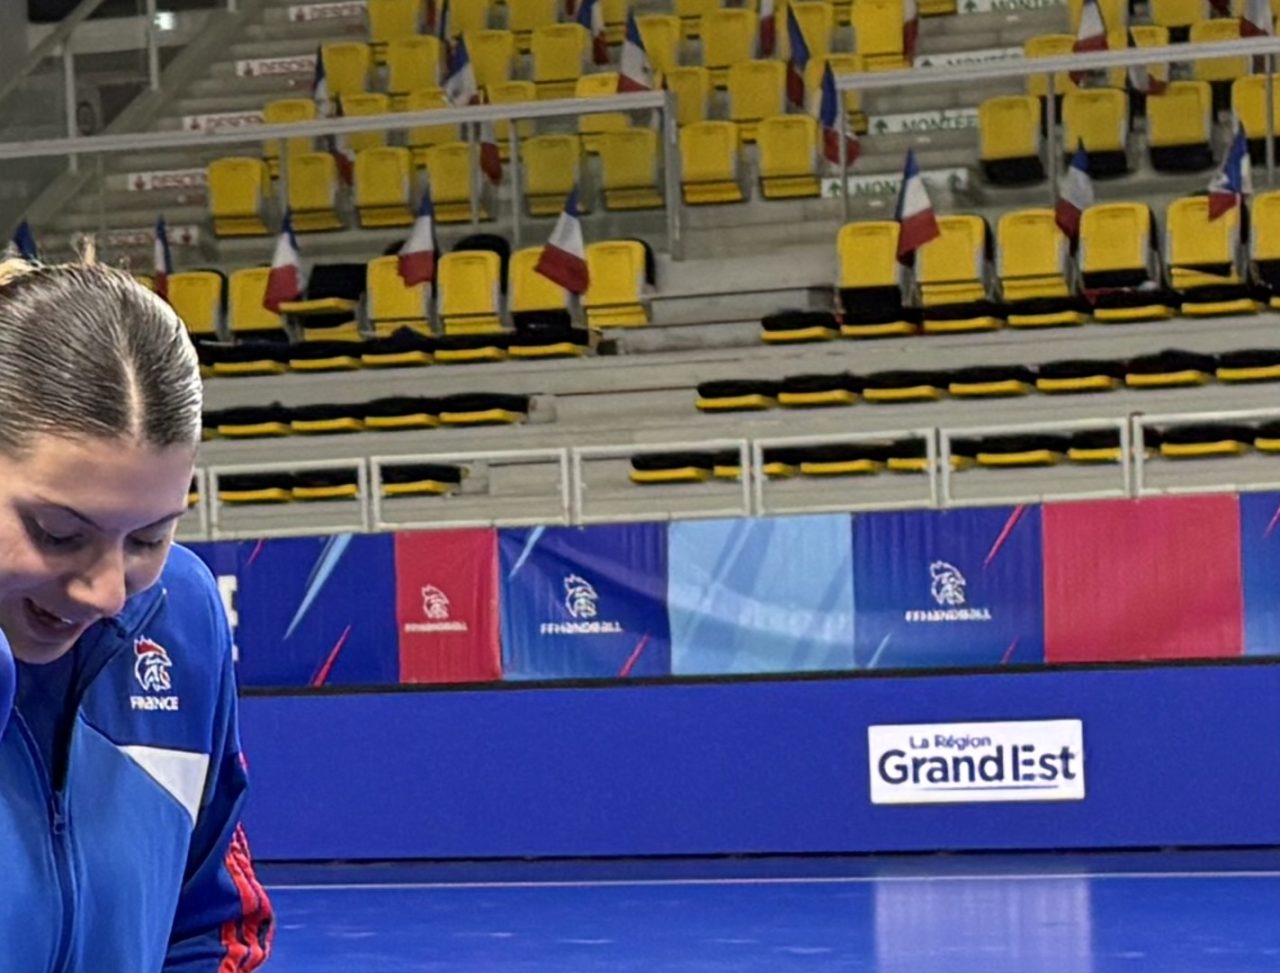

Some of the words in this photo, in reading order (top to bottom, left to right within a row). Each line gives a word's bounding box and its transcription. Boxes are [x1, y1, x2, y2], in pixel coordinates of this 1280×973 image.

[130, 695, 179, 711] FRANCE
[909, 735, 930, 749] La
[934, 734, 992, 751] Région
